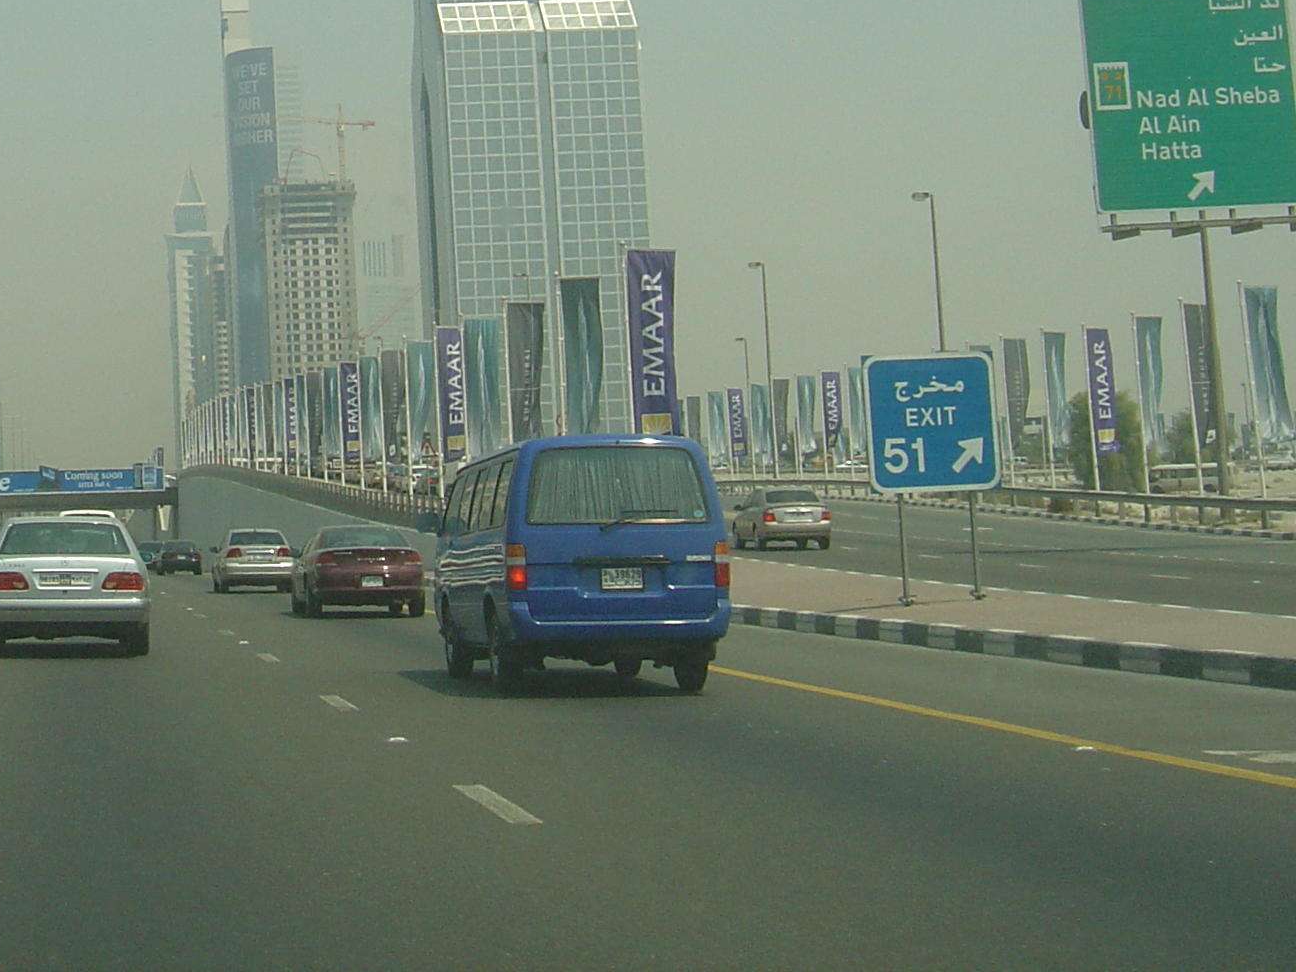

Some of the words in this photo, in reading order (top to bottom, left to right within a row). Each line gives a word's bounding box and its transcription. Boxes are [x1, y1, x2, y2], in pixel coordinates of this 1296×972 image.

[1234, 25, 1283, 46] العين
[1104, 84, 1123, 101] 71
[1137, 90, 1180, 109] Nad
[1187, 88, 1209, 106] Al
[1215, 86, 1280, 105] Sheba
[1139, 116, 1161, 134] Al
[1167, 116, 1200, 133] Ain
[1142, 142, 1202, 160] Hatta
[641, 271, 665, 397] EMAAR
[447, 341, 464, 424] EMAAR
[894, 375, 965, 402] مخرج
[1094, 340, 1112, 419] EMAAR
[347, 373, 360, 433] EMAAR
[731, 394, 742, 438] EMAAR
[826, 380, 838, 430] EMAAR
[905, 406, 957, 427] EXIT
[883, 437, 926, 474] 51
[64, 470, 99, 481] Coming
[101, 471, 123, 480] soon
